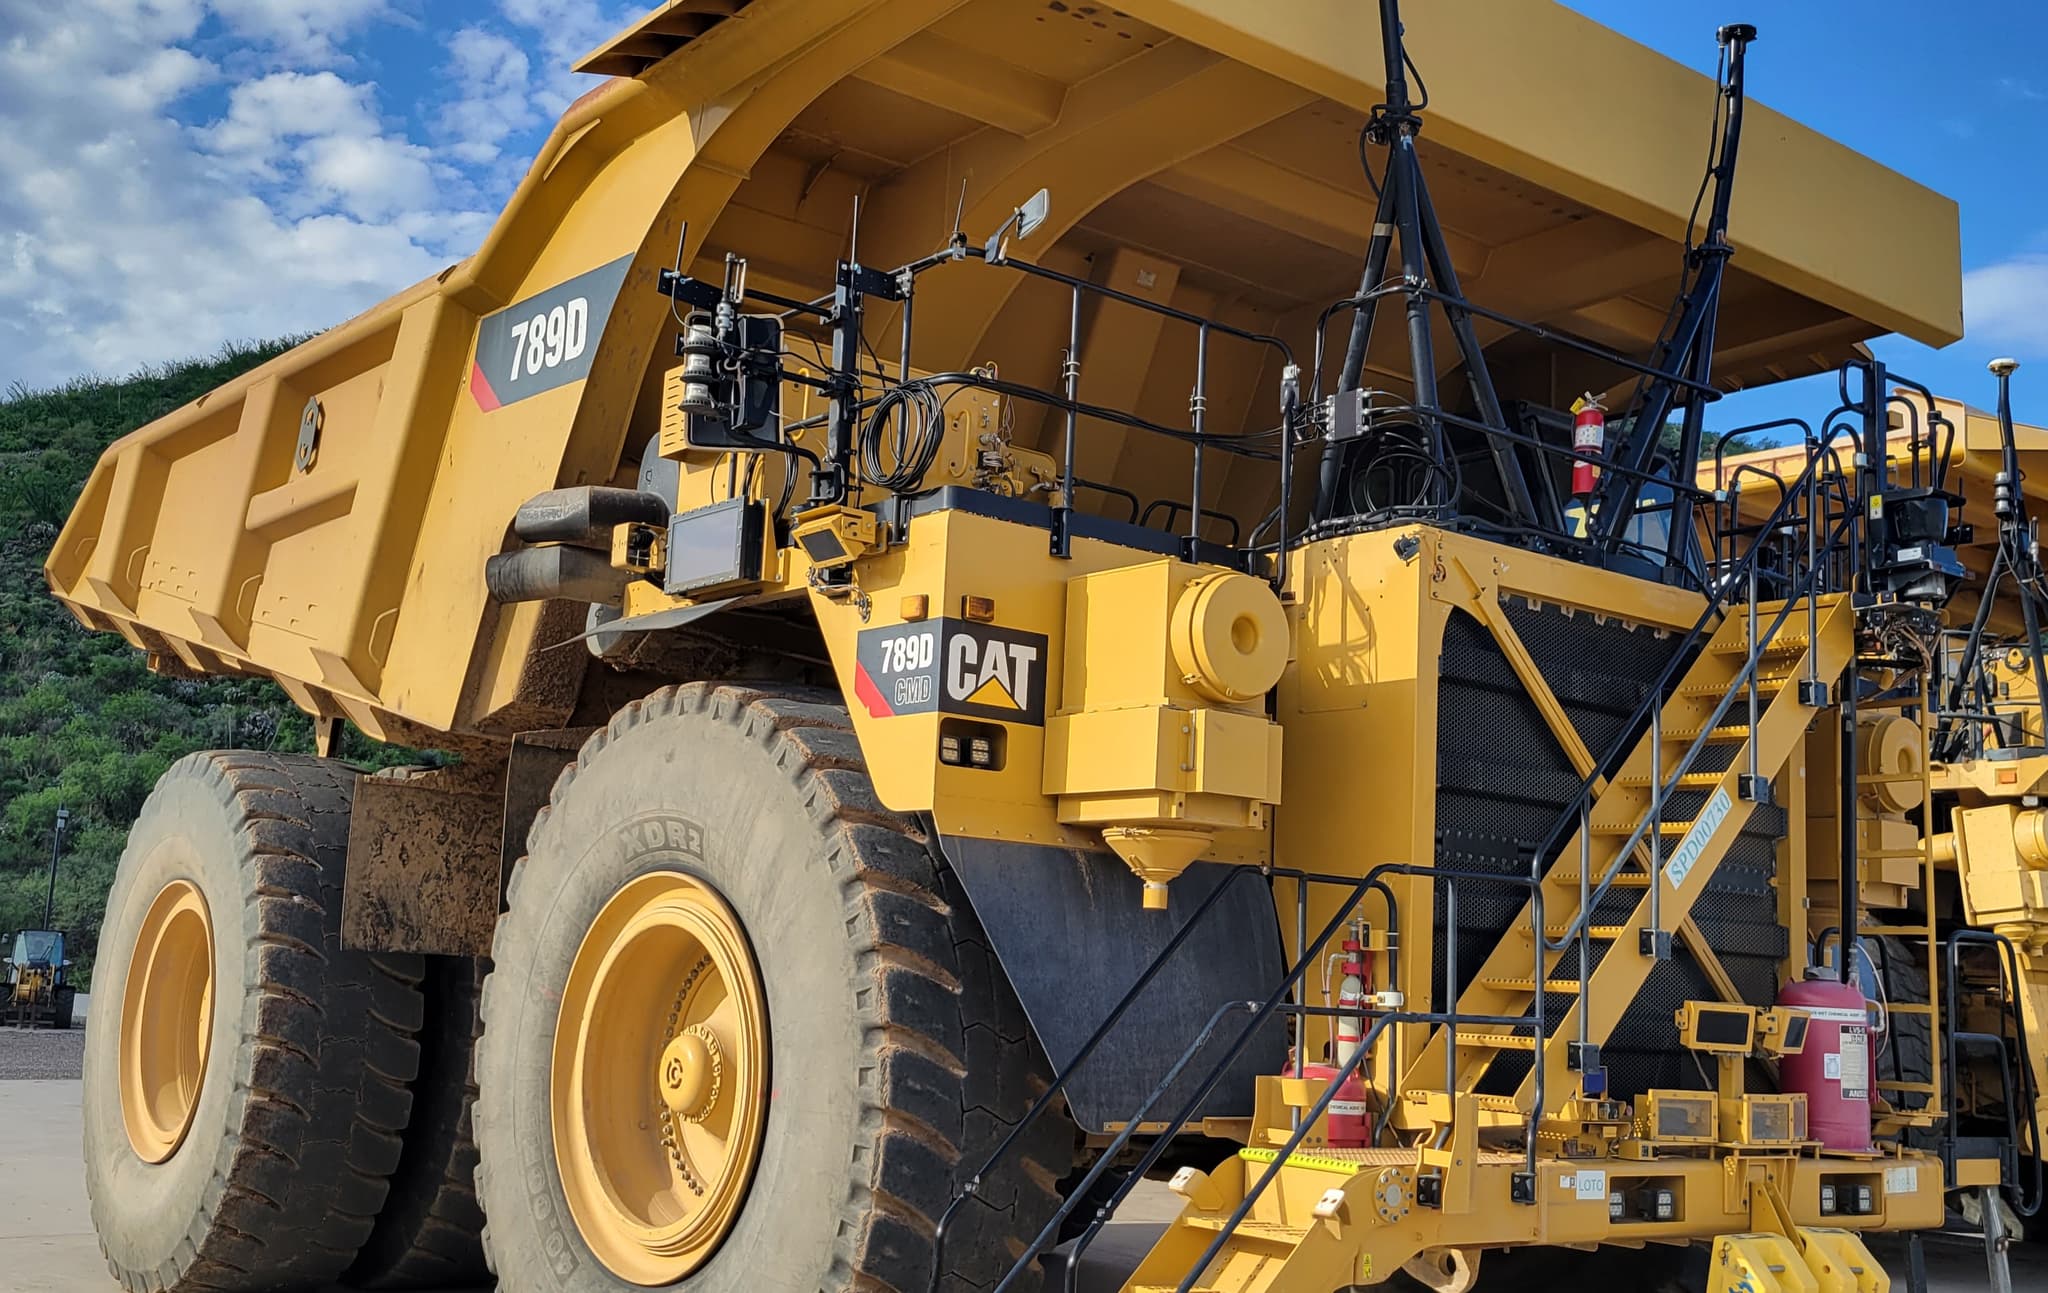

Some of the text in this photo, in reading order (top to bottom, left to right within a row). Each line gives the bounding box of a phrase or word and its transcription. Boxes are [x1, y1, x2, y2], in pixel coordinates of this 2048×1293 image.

[510, 297, 588, 382] 789D
[881, 633, 934, 673] 789D
[947, 633, 1037, 711] CAT
[894, 675, 932, 706] CMD
[619, 820, 701, 859] XDR2
[1671, 793, 1730, 883] SPD00730
[1578, 1178, 1604, 1192] LOTO
